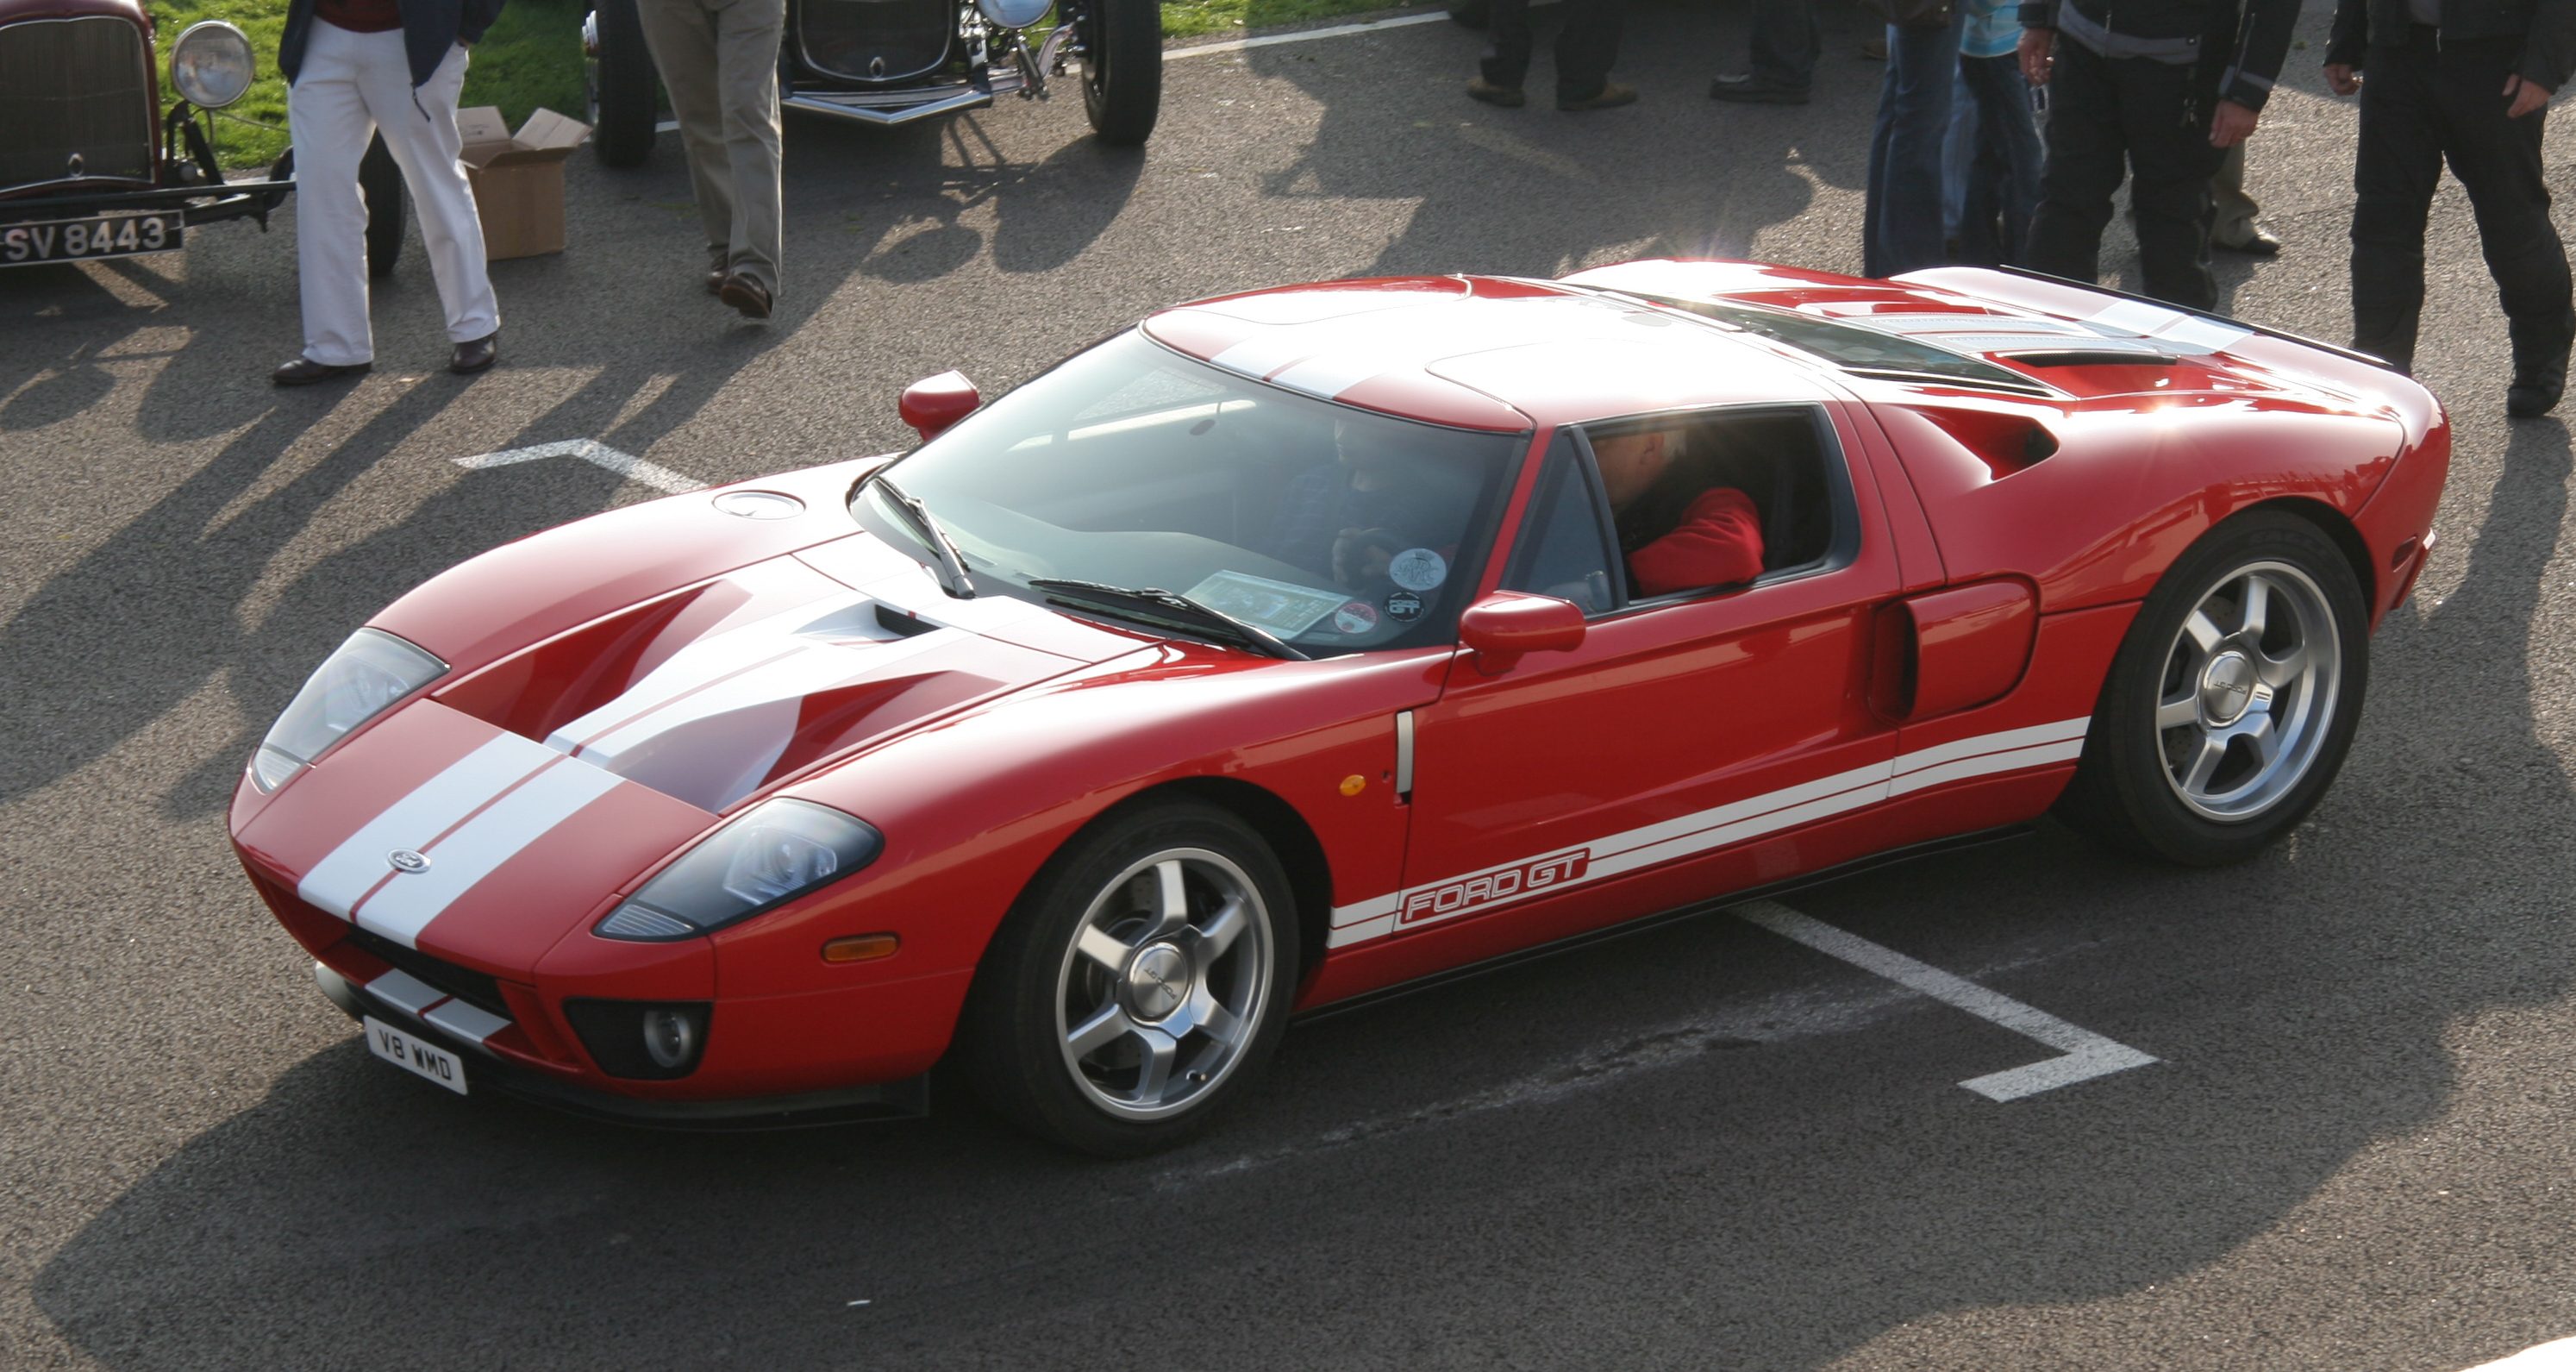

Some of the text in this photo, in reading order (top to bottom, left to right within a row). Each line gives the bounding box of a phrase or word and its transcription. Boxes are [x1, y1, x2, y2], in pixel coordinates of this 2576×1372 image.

[5, 217, 167, 260] SV 8443
[1389, 605, 1421, 614] GT
[1405, 851, 1586, 921] FORD GT
[378, 1029, 452, 1081] V8 WMD
